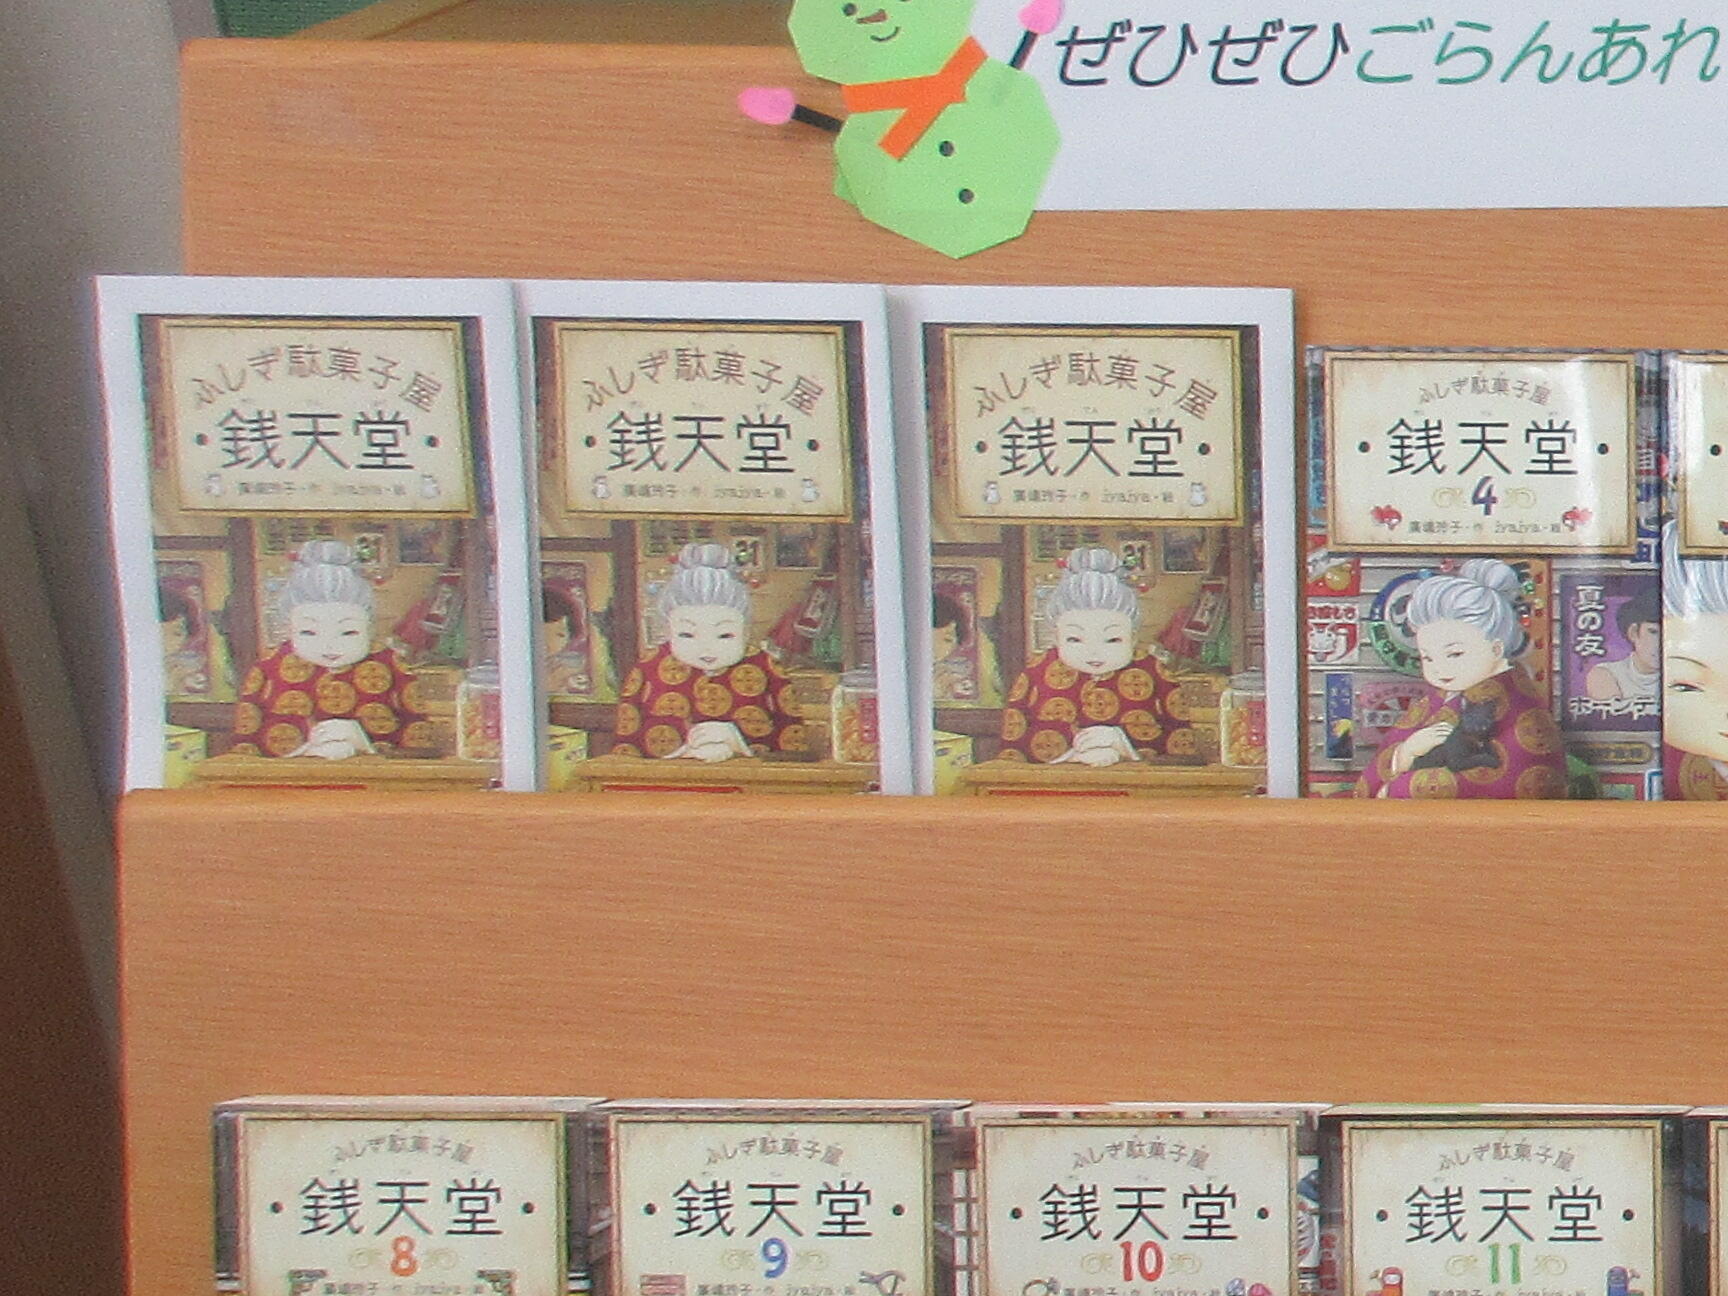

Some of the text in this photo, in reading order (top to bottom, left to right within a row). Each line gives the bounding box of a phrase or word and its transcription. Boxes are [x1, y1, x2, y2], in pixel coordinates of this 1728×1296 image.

[583, 346, 826, 417] ふしぎ駄菓子屋
[972, 351, 1219, 421] ふしぎ駄菓子屋
[217, 407, 415, 471] 銭天堂
[606, 410, 794, 474] 銭天堂
[998, 415, 1185, 478] 銭天堂
[1386, 417, 1578, 477] 銭天堂
[1471, 475, 1499, 516] 4
[1575, 584, 1605, 657] 夏の友
[298, 1176, 505, 1237] 銭天堂
[672, 1178, 873, 1239] 銭天堂
[1038, 1182, 1239, 1243] 銭天堂
[1404, 1184, 1605, 1244] 銭天堂
[389, 1236, 419, 1277] 8
[761, 1237, 789, 1279] 9
[1120, 1240, 1165, 1282] 10
[1487, 1242, 1523, 1285] 11
